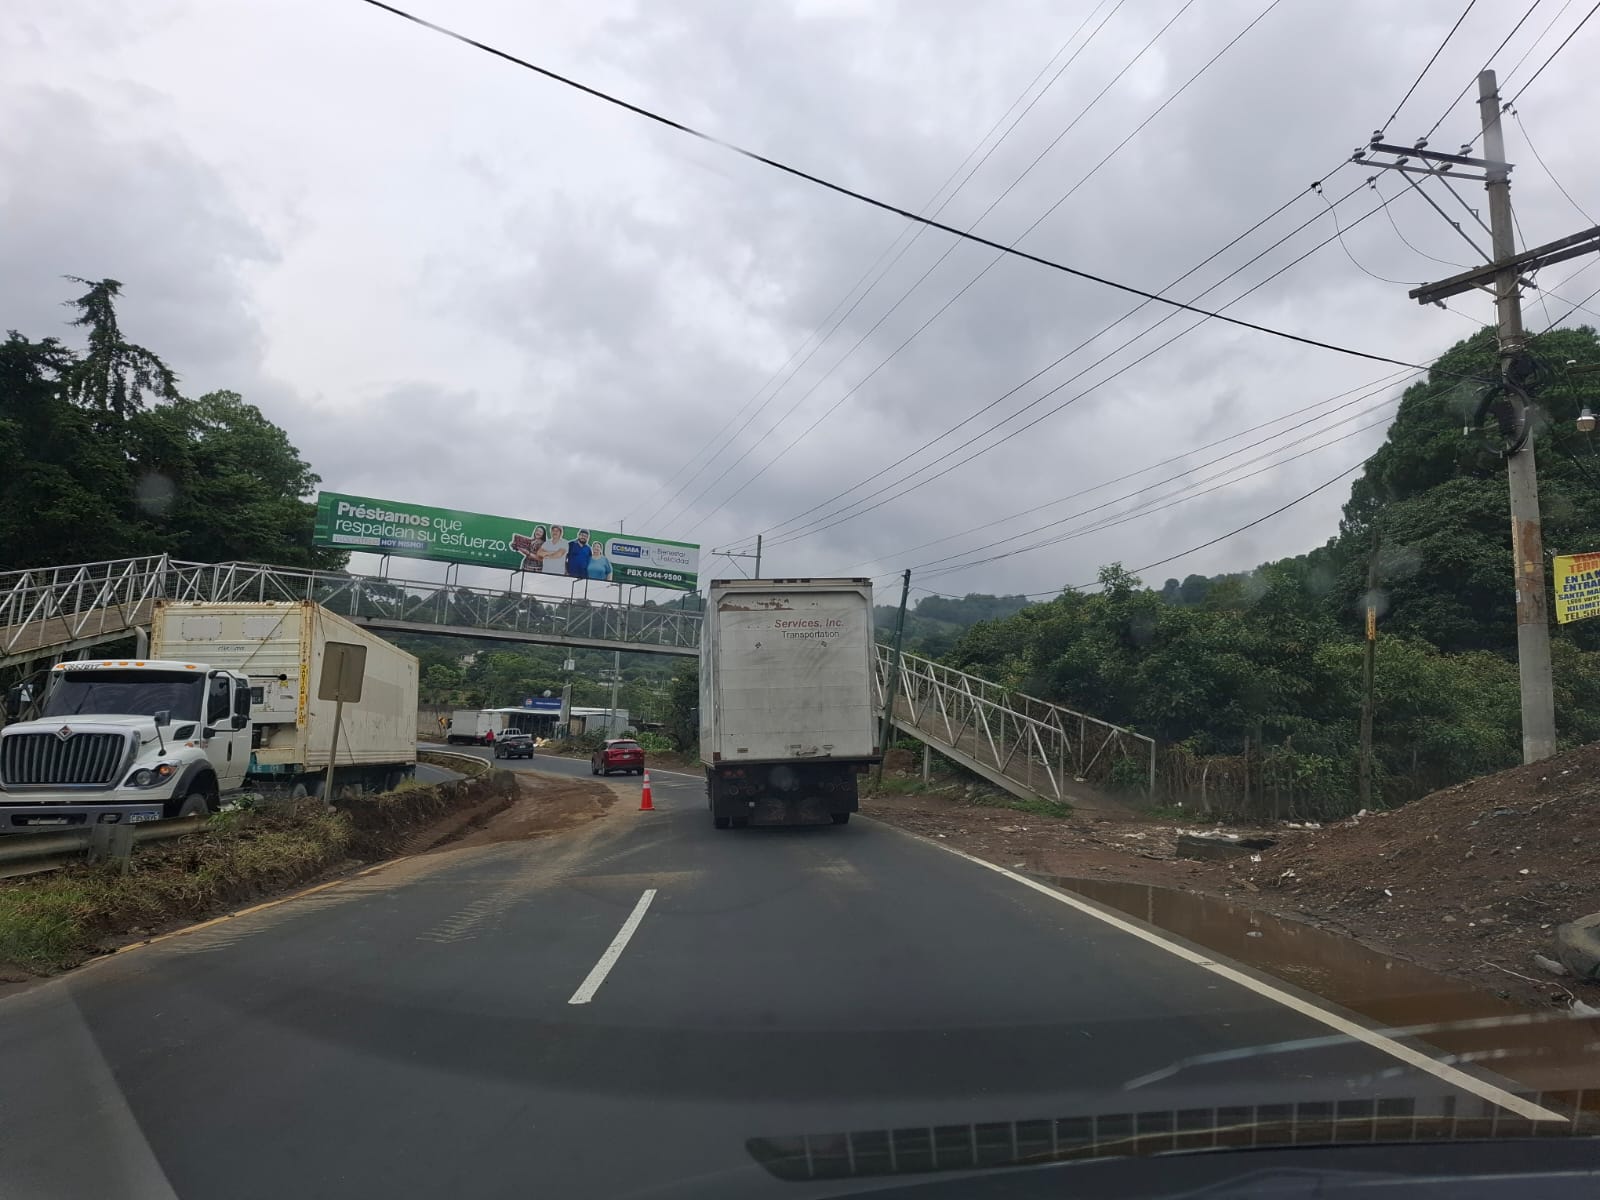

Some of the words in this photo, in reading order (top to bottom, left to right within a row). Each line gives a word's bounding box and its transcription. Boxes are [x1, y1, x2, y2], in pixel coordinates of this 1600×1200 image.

[337, 501, 430, 526] Préstamos
[433, 516, 463, 533] que
[335, 518, 415, 540] respaldan
[417, 529, 437, 542] su
[440, 532, 507, 552] esfuerzo.
[381, 539, 397, 547] HOY
[627, 568, 642, 576] PBX
[643, 572, 682, 581] 6644-9500
[1565, 575, 1578, 583] EN
[1580, 572, 1593, 581] LA
[1558, 592, 1585, 600] SANTA
[774, 619, 822, 628] Services,
[781, 630, 840, 639] Transportation
